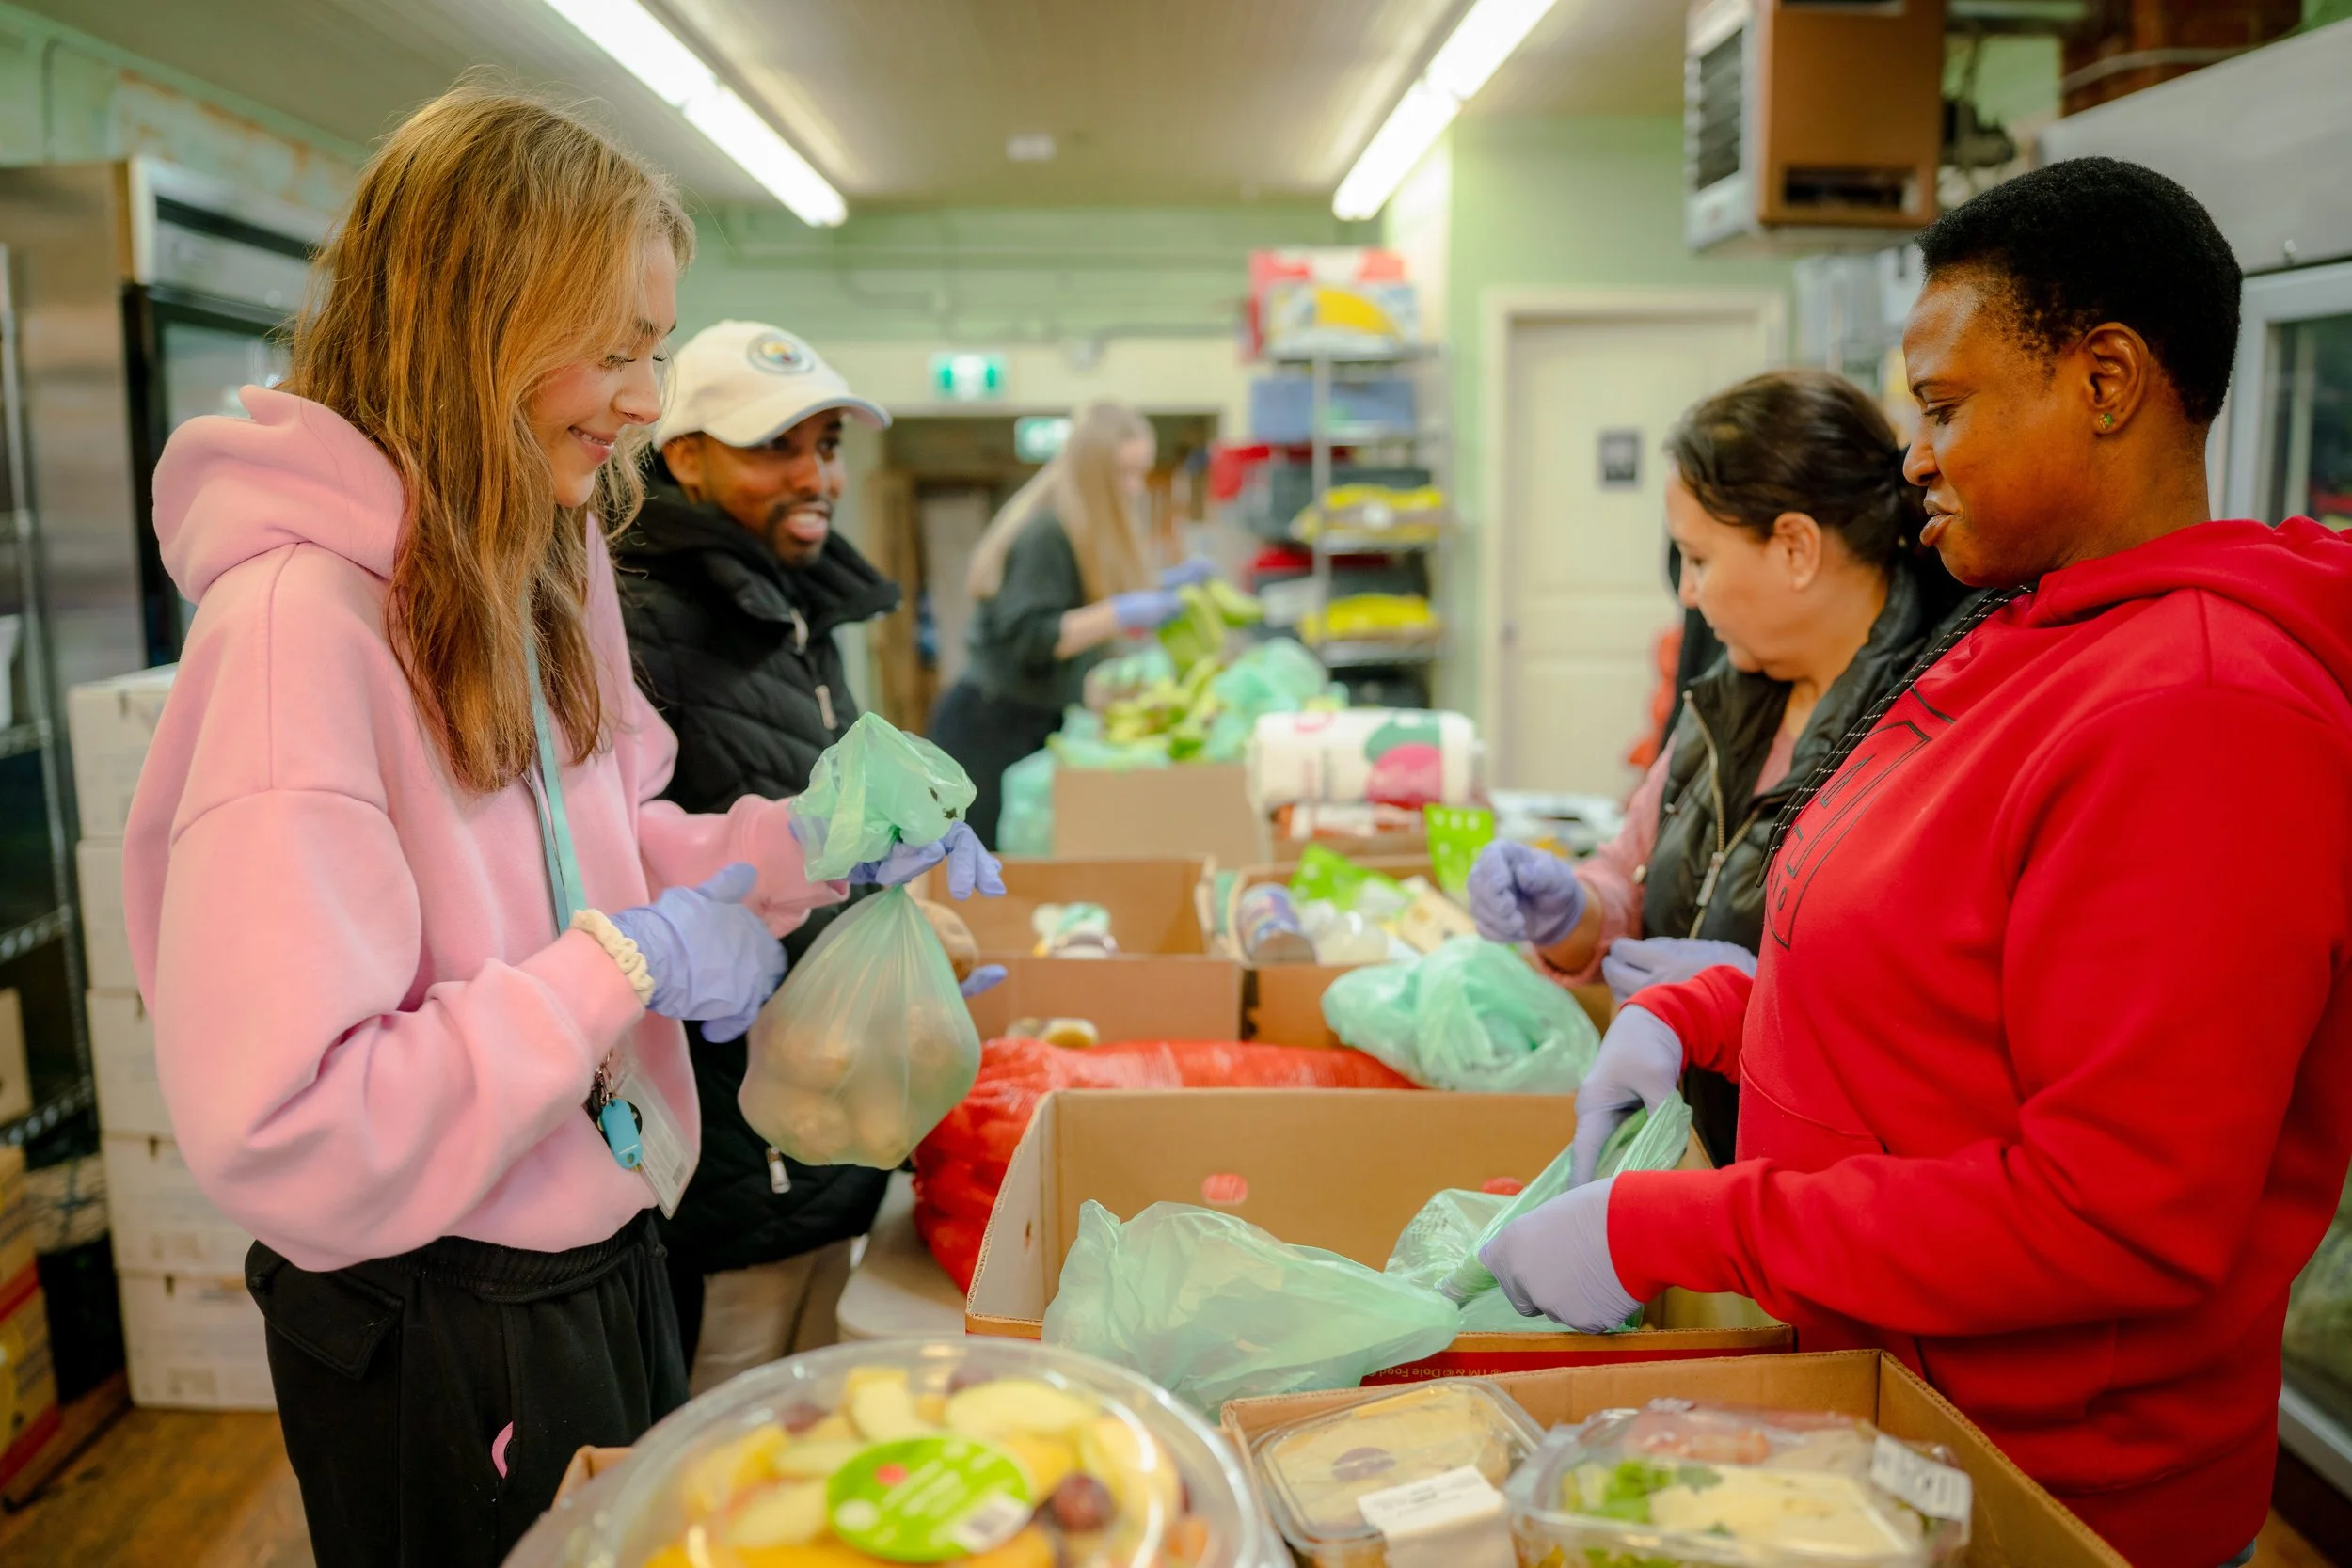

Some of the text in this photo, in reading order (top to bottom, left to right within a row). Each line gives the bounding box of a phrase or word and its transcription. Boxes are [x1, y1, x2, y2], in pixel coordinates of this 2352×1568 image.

[1379, 1368, 1409, 1378] Food
[1412, 1368, 1441, 1378] Dole
[1442, 1369, 1454, 1377] ©
[1455, 1369, 1466, 1377] &
